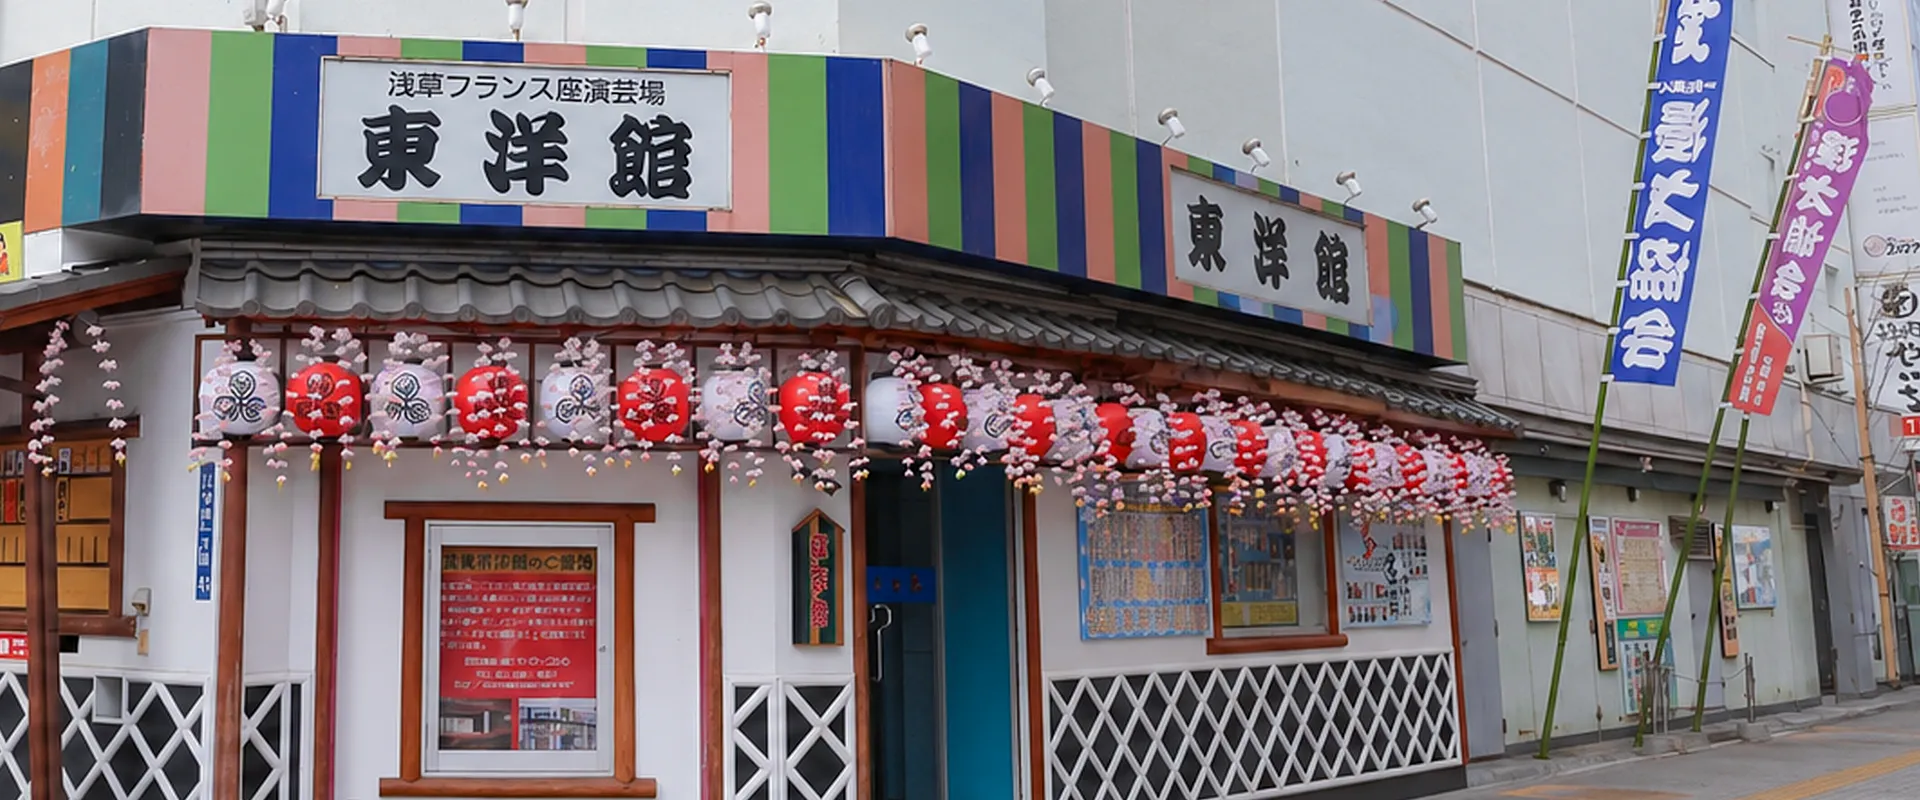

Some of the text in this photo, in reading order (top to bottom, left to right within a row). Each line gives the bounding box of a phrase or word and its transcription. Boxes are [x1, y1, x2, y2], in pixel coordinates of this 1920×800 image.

[388, 70, 666, 106] 浅草フランス座演芸場
[357, 104, 693, 199] 東洋館
[1186, 194, 1350, 306] 東洋館
